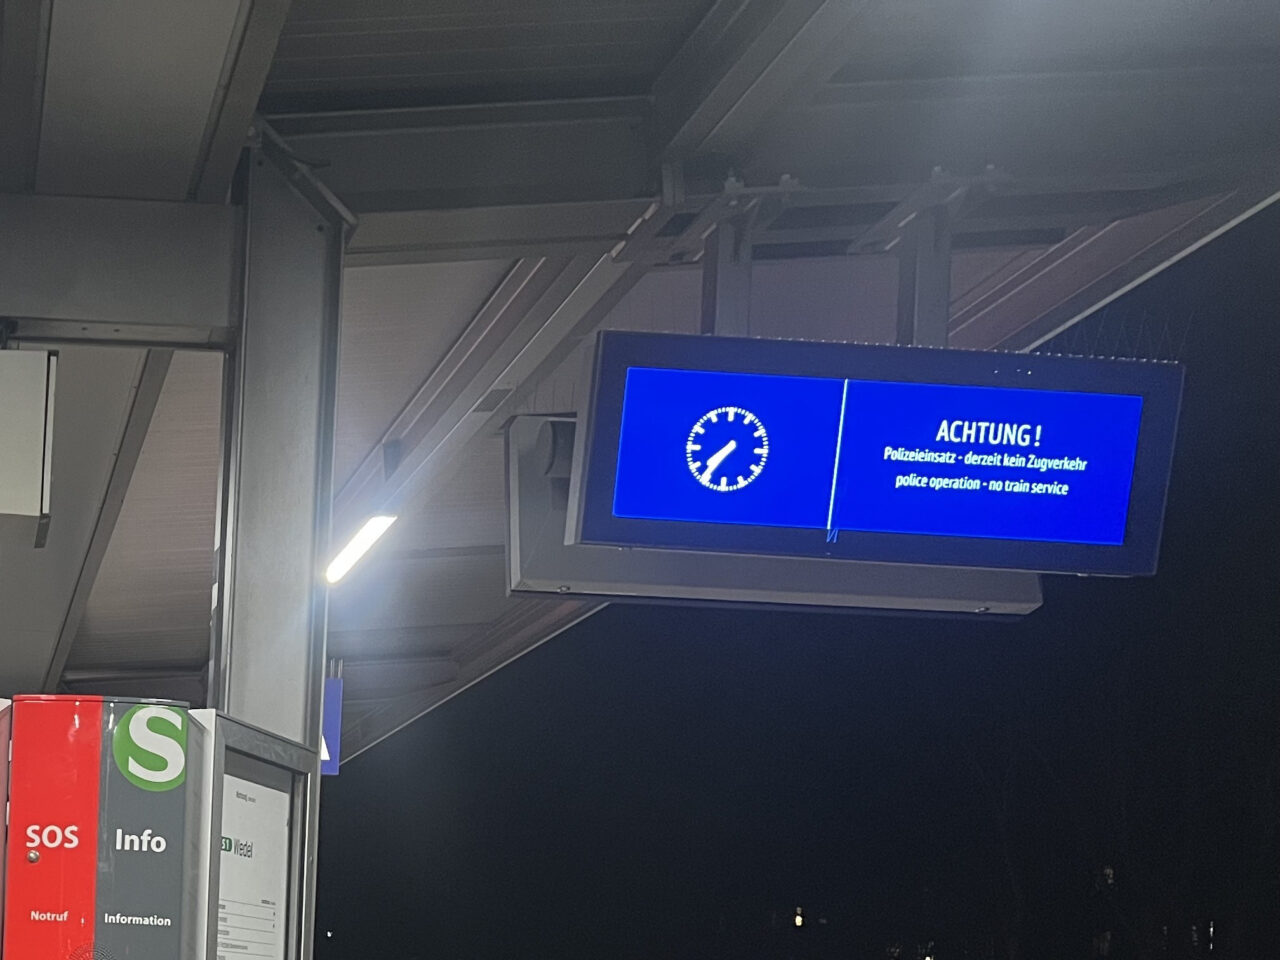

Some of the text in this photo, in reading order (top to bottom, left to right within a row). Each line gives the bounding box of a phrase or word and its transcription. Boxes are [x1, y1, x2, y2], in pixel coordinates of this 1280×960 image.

[935, 419, 1031, 447] ACHTUNG
[883, 446, 956, 464] Polizeieinsatz
[964, 451, 1002, 467] derzeit
[1003, 453, 1026, 468] kein
[1027, 454, 1088, 472] Zugverkehr
[895, 473, 928, 489] police
[929, 477, 981, 491] operation
[988, 480, 1003, 491] no
[1004, 479, 1029, 493] train
[1030, 481, 1069, 495] service
[128, 707, 185, 783] S
[25, 824, 79, 849] SOS
[115, 828, 167, 853] Info
[233, 839, 254, 858] Wedel
[30, 909, 69, 922] Notruf
[104, 912, 172, 926] Information
